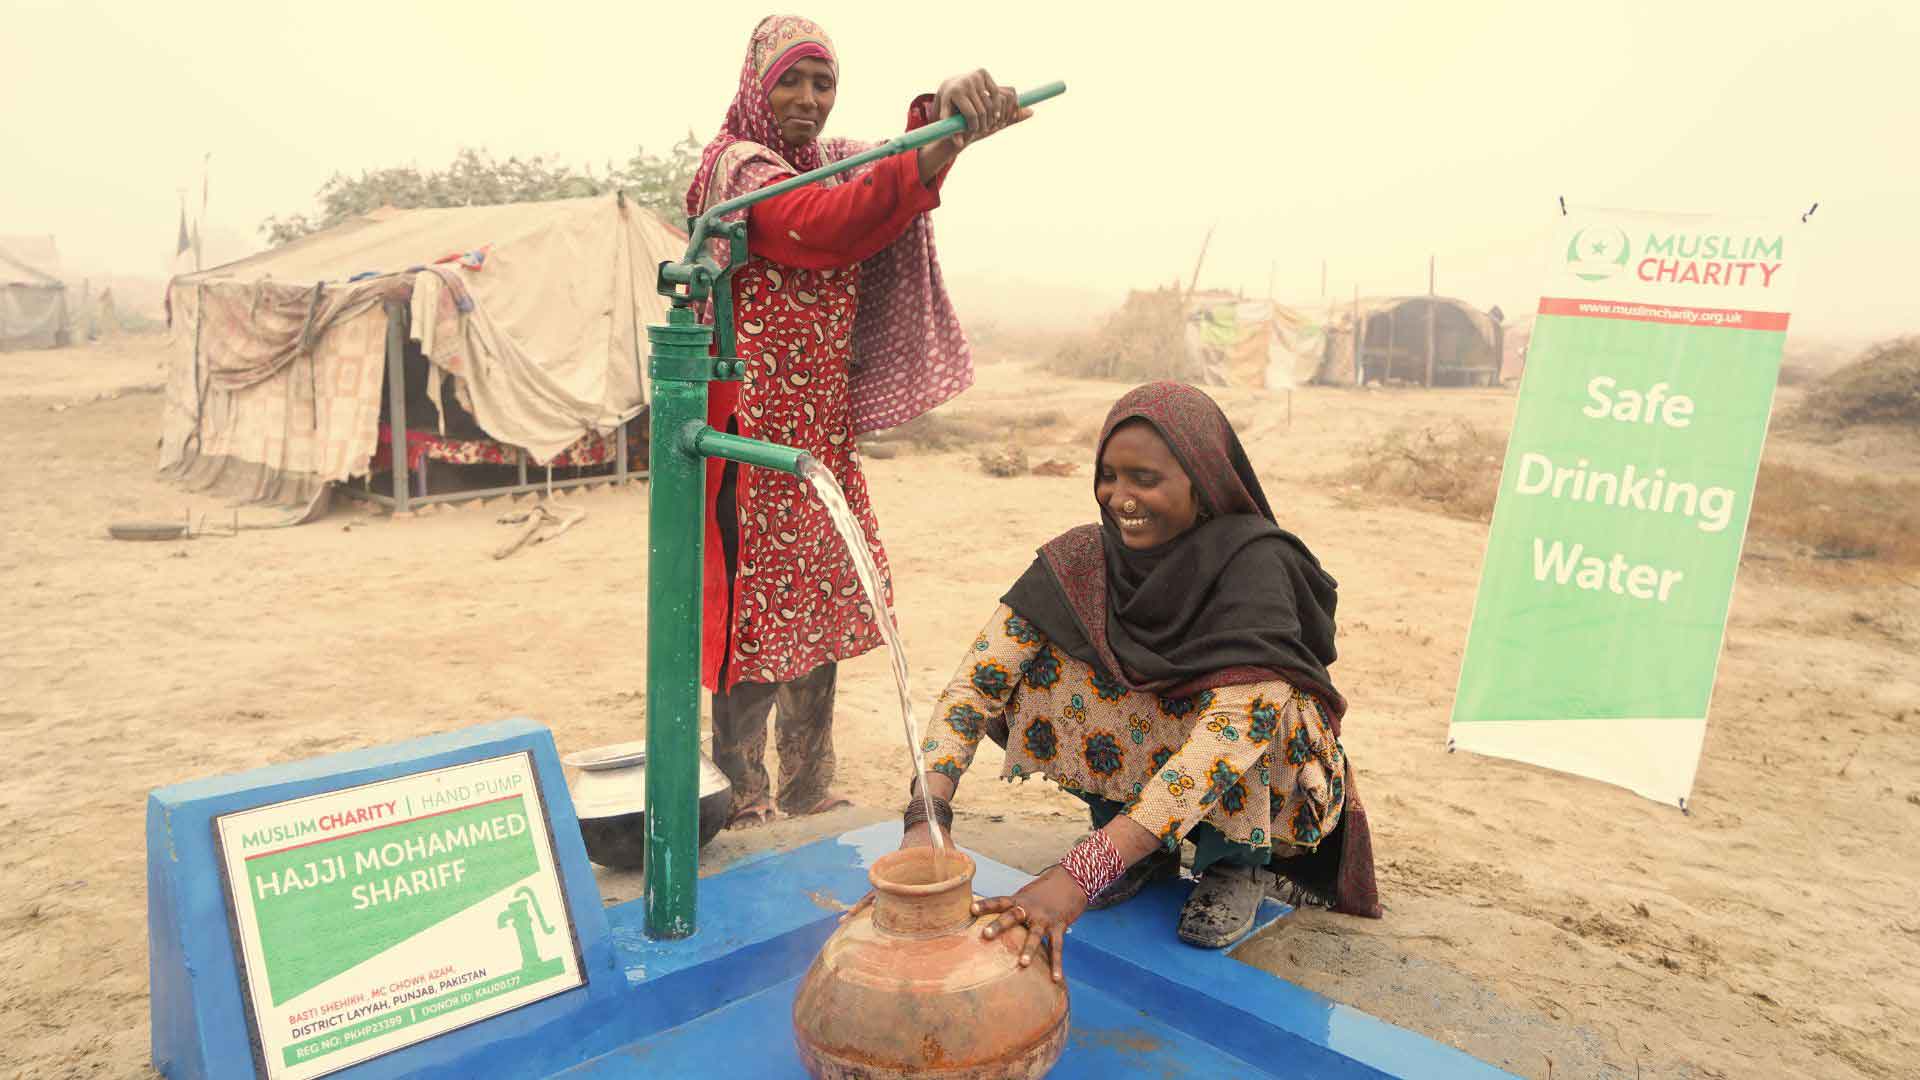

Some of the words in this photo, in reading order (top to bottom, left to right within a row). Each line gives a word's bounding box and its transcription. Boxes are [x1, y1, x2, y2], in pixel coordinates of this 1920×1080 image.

[1645, 232, 1784, 260] MUSLIM
[1637, 258, 1782, 288] CHARITY
[1578, 302, 1743, 324] www.muslimcharity.org.uk
[1582, 375, 1695, 428] Safe
[1515, 452, 1737, 532] Drinking
[1532, 537, 1684, 601] Water
[422, 783, 472, 811] HAND
[474, 773, 524, 800] PUMP
[255, 856, 347, 900] HAJJI
[354, 812, 527, 876] MOHAMMED
[351, 858, 467, 911] SHARIFF
[288, 1007, 319, 1025] BASTI
[292, 1013, 345, 1039] DISTRICT
[440, 968, 487, 989] PAKISTAN
[421, 997, 460, 1017] DONOR
